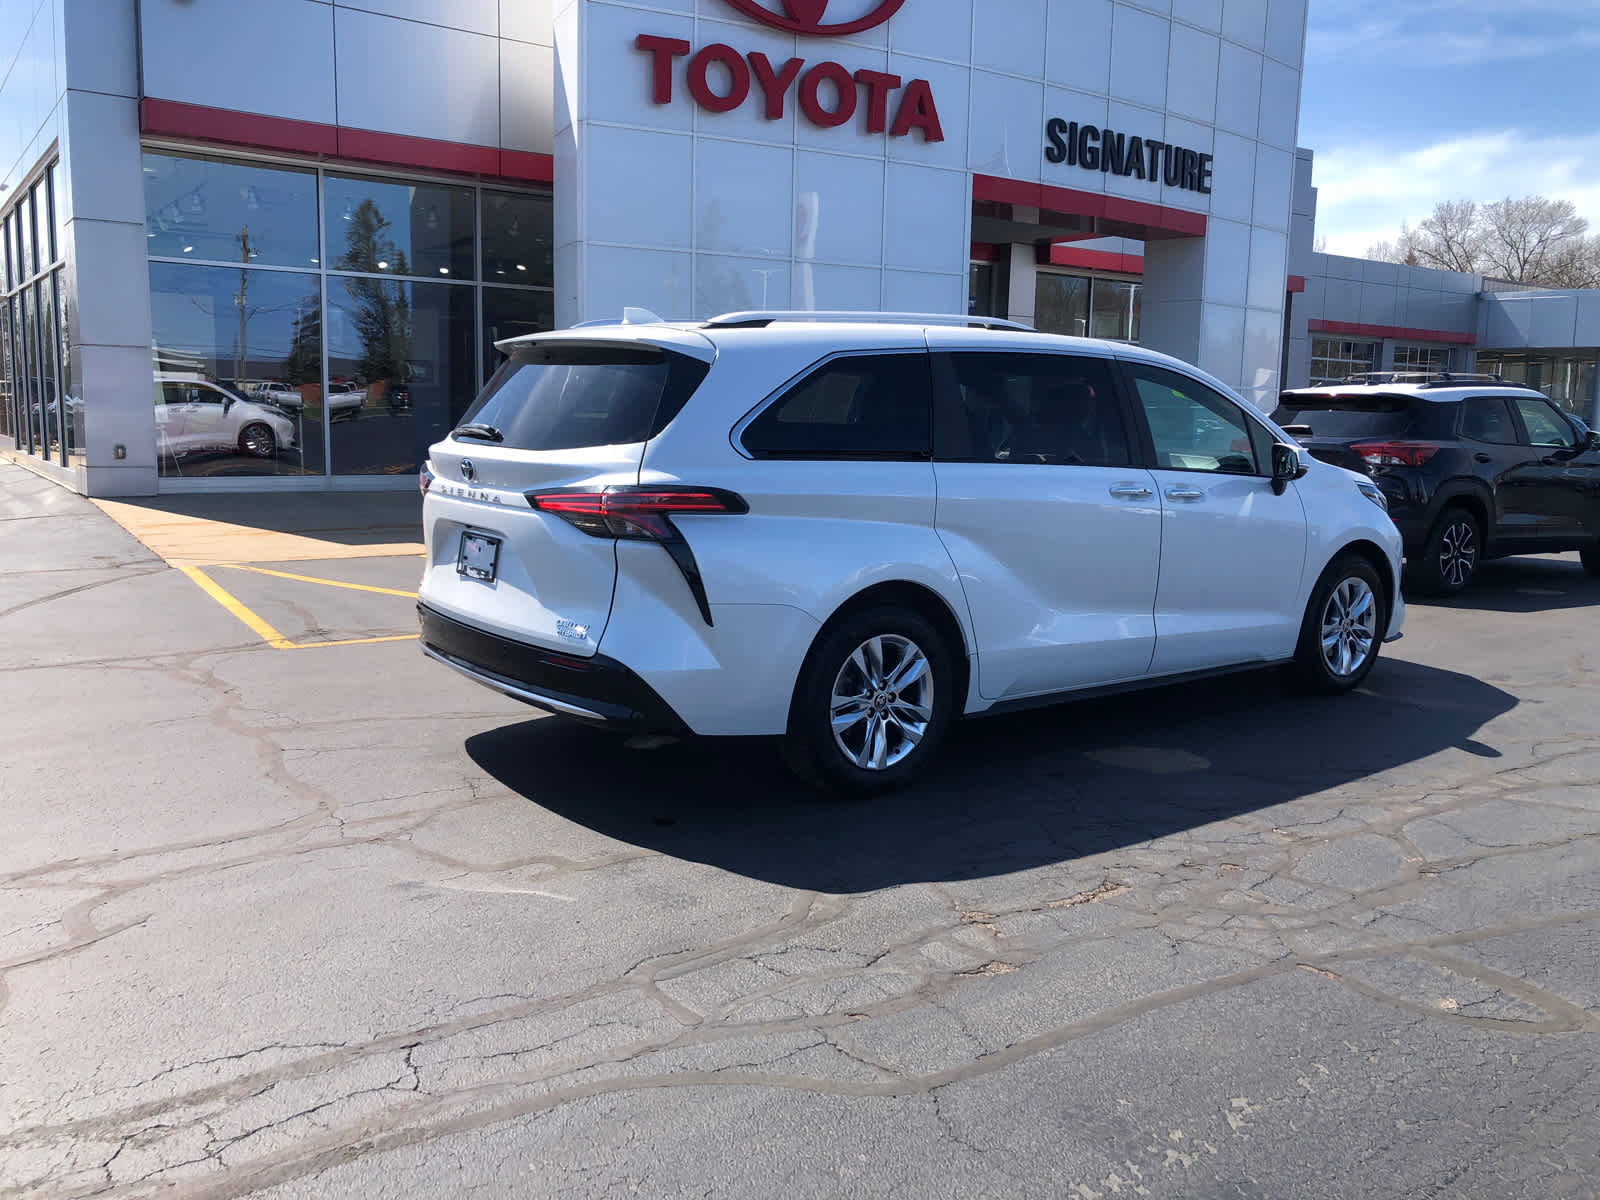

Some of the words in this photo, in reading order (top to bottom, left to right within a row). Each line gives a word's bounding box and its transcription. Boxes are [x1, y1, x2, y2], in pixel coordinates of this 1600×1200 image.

[635, 33, 945, 142] TOYOTA
[1045, 117, 1213, 194] SIGNATURE
[440, 484, 503, 504] SIENNA
